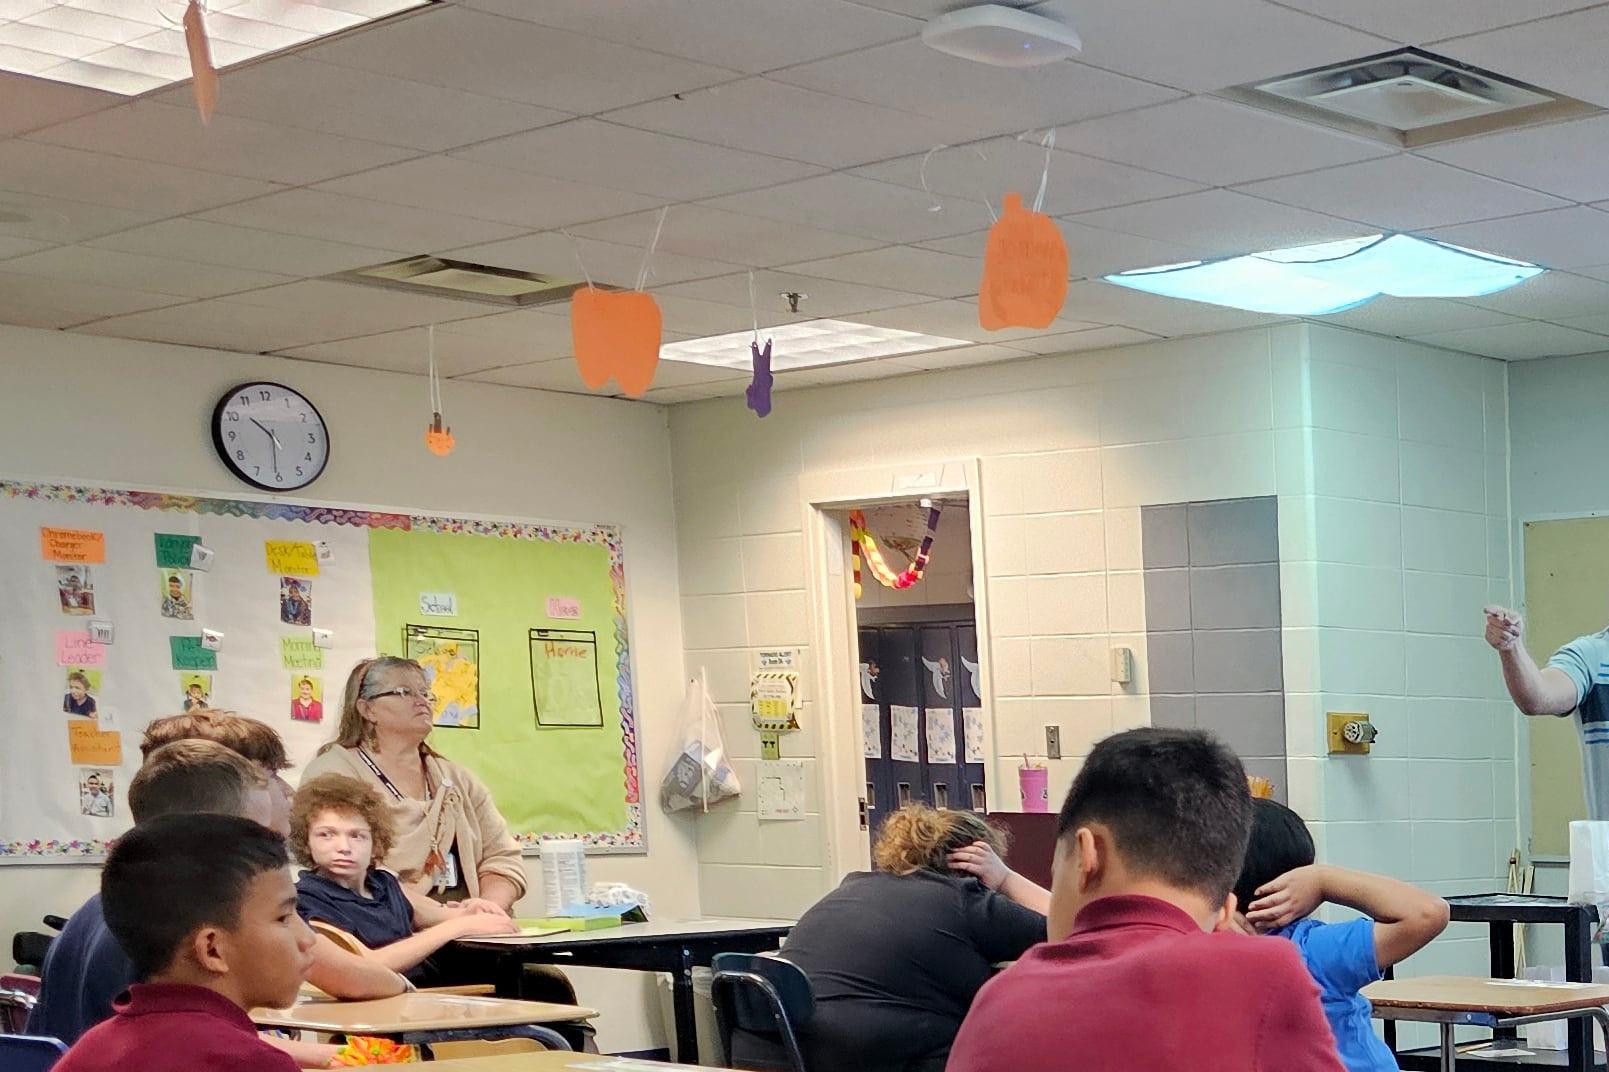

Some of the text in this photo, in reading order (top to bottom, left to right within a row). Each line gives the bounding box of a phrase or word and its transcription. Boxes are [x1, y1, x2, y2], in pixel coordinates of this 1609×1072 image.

[240, 396, 250, 407] 11
[259, 391, 271, 401] 12
[285, 398, 291, 409] 1
[226, 411, 240, 422] 10
[300, 413, 307, 423] 2
[228, 431, 237, 442] 9
[307, 432, 316, 444] 3
[236, 450, 245, 461] 8
[304, 452, 312, 462] 4
[254, 466, 260, 476] 7
[295, 466, 303, 477] 5
[275, 472, 283, 483] 6
[544, 640, 587, 660] Home
